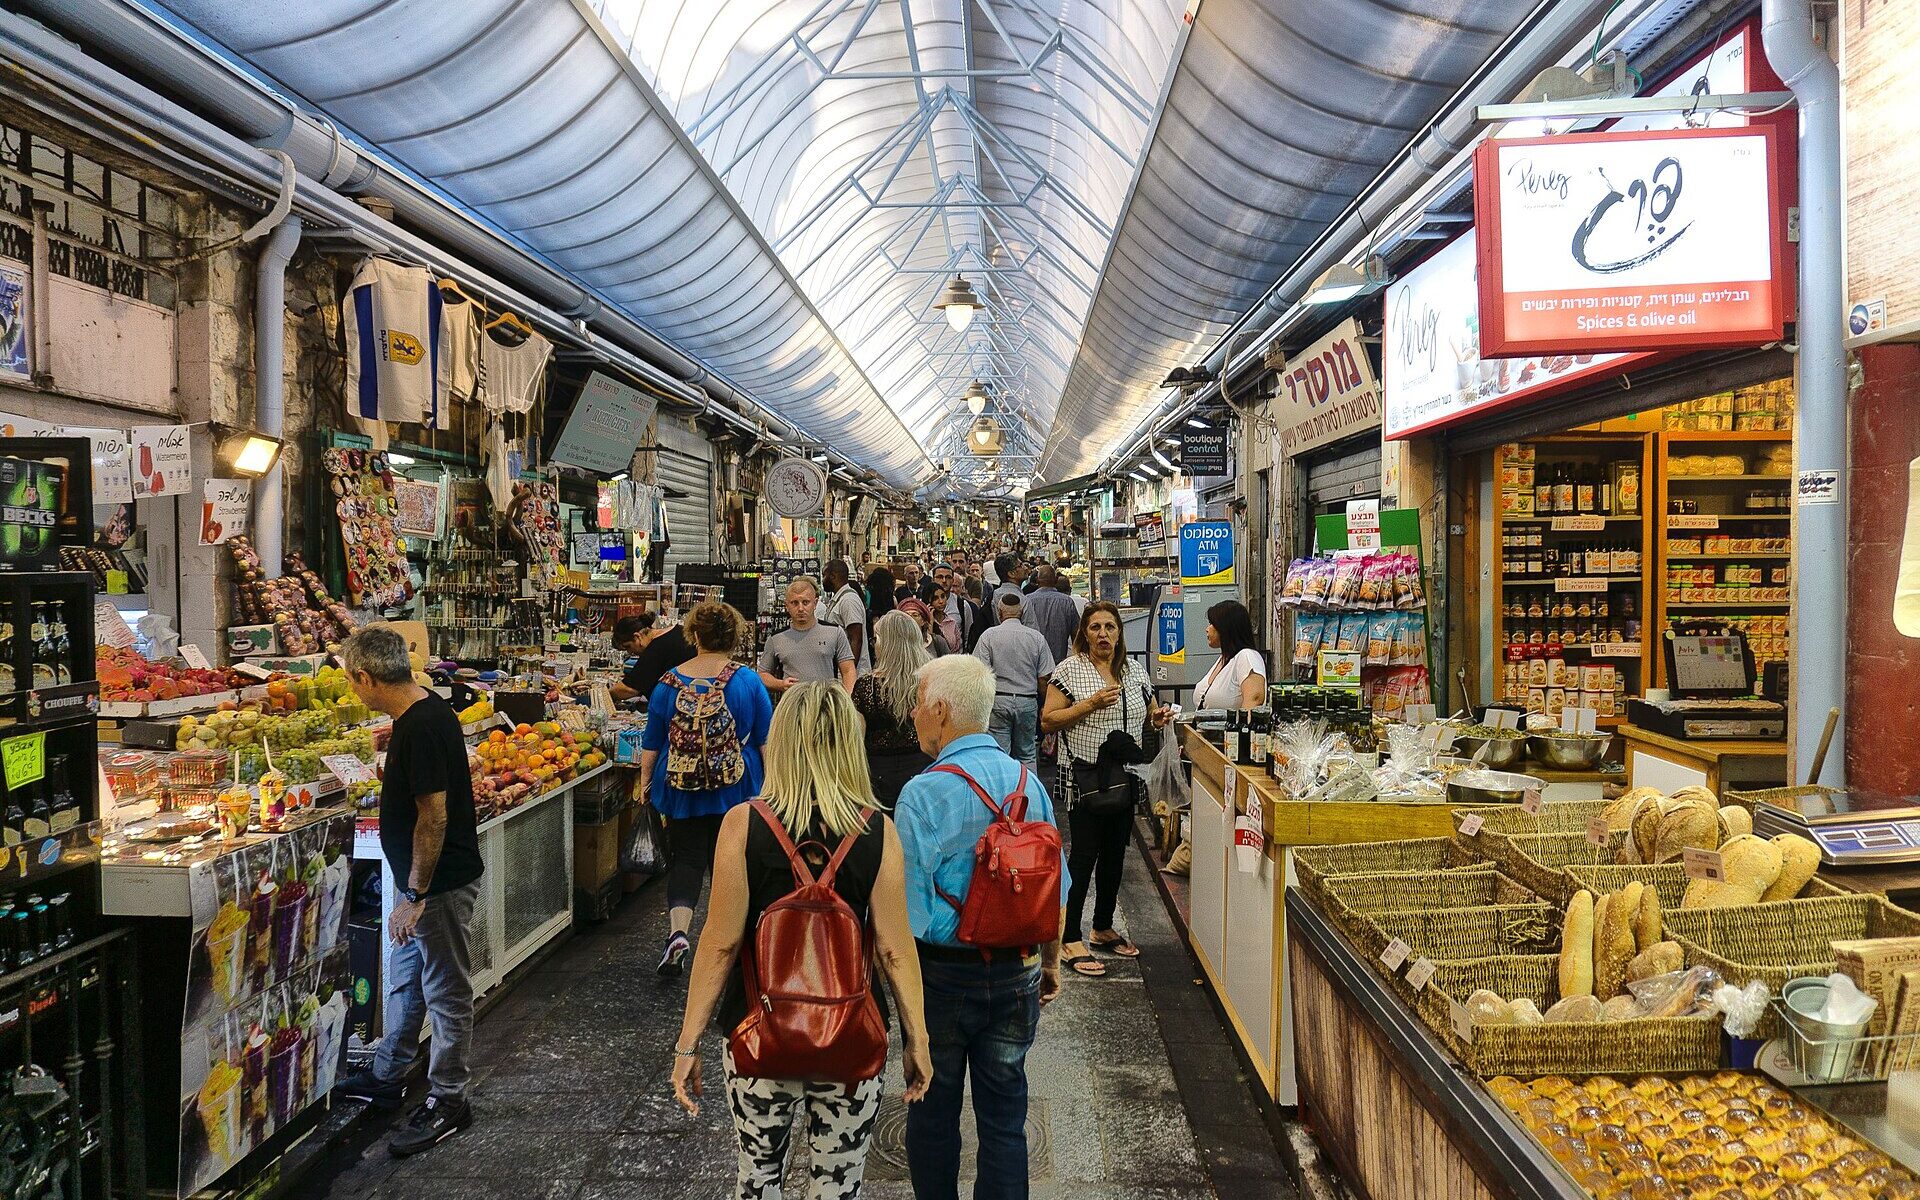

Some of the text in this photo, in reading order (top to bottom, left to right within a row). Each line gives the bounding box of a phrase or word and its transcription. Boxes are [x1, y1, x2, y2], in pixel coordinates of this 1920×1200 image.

[1507, 157, 1572, 200] Pereg
[1521, 289, 1750, 311] תבלינים, שמן זית, קטניות ופירות יבשים
[1576, 310, 1696, 331] Spices & olive oil
[157, 428, 185, 448] אבטיח
[1184, 434, 1223, 445] boutique
[96, 439, 124, 454] תפוח
[1187, 445, 1220, 453] central
[1351, 513, 1374, 521] מבצע
[1183, 526, 1229, 540] כספומט
[1198, 540, 1219, 551] ATM
[1166, 620, 1177, 630] ATM
[44, 696, 84, 709] CHOUFFE
